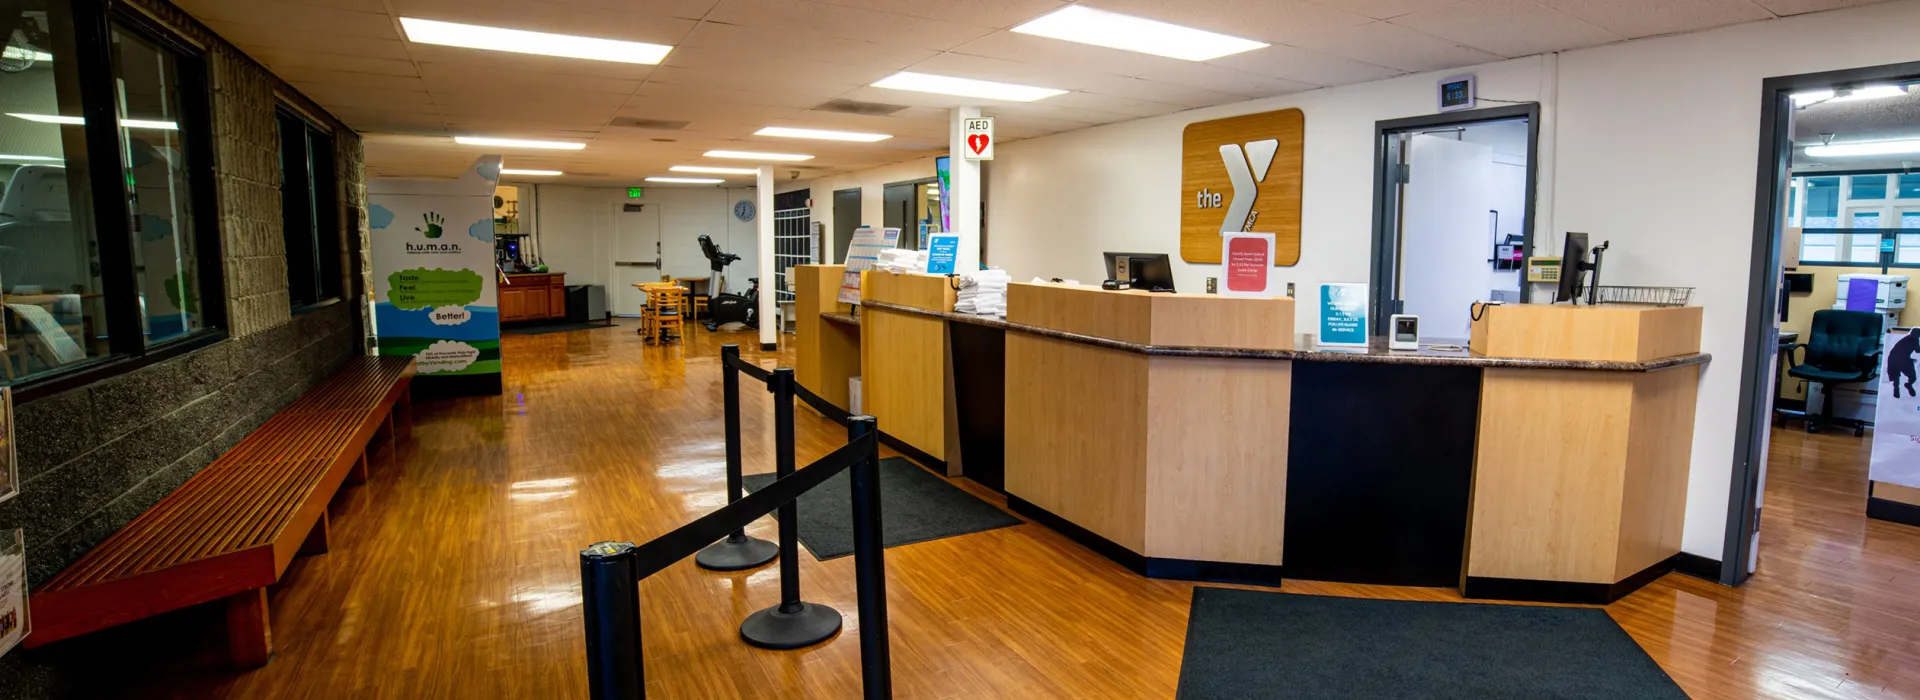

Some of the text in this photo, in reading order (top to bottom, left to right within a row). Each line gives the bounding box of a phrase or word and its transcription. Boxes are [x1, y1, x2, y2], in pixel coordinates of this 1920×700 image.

[969, 121, 989, 130] AED
[1197, 188, 1222, 208] the
[406, 242, 462, 251] h.u.m.a.n.
